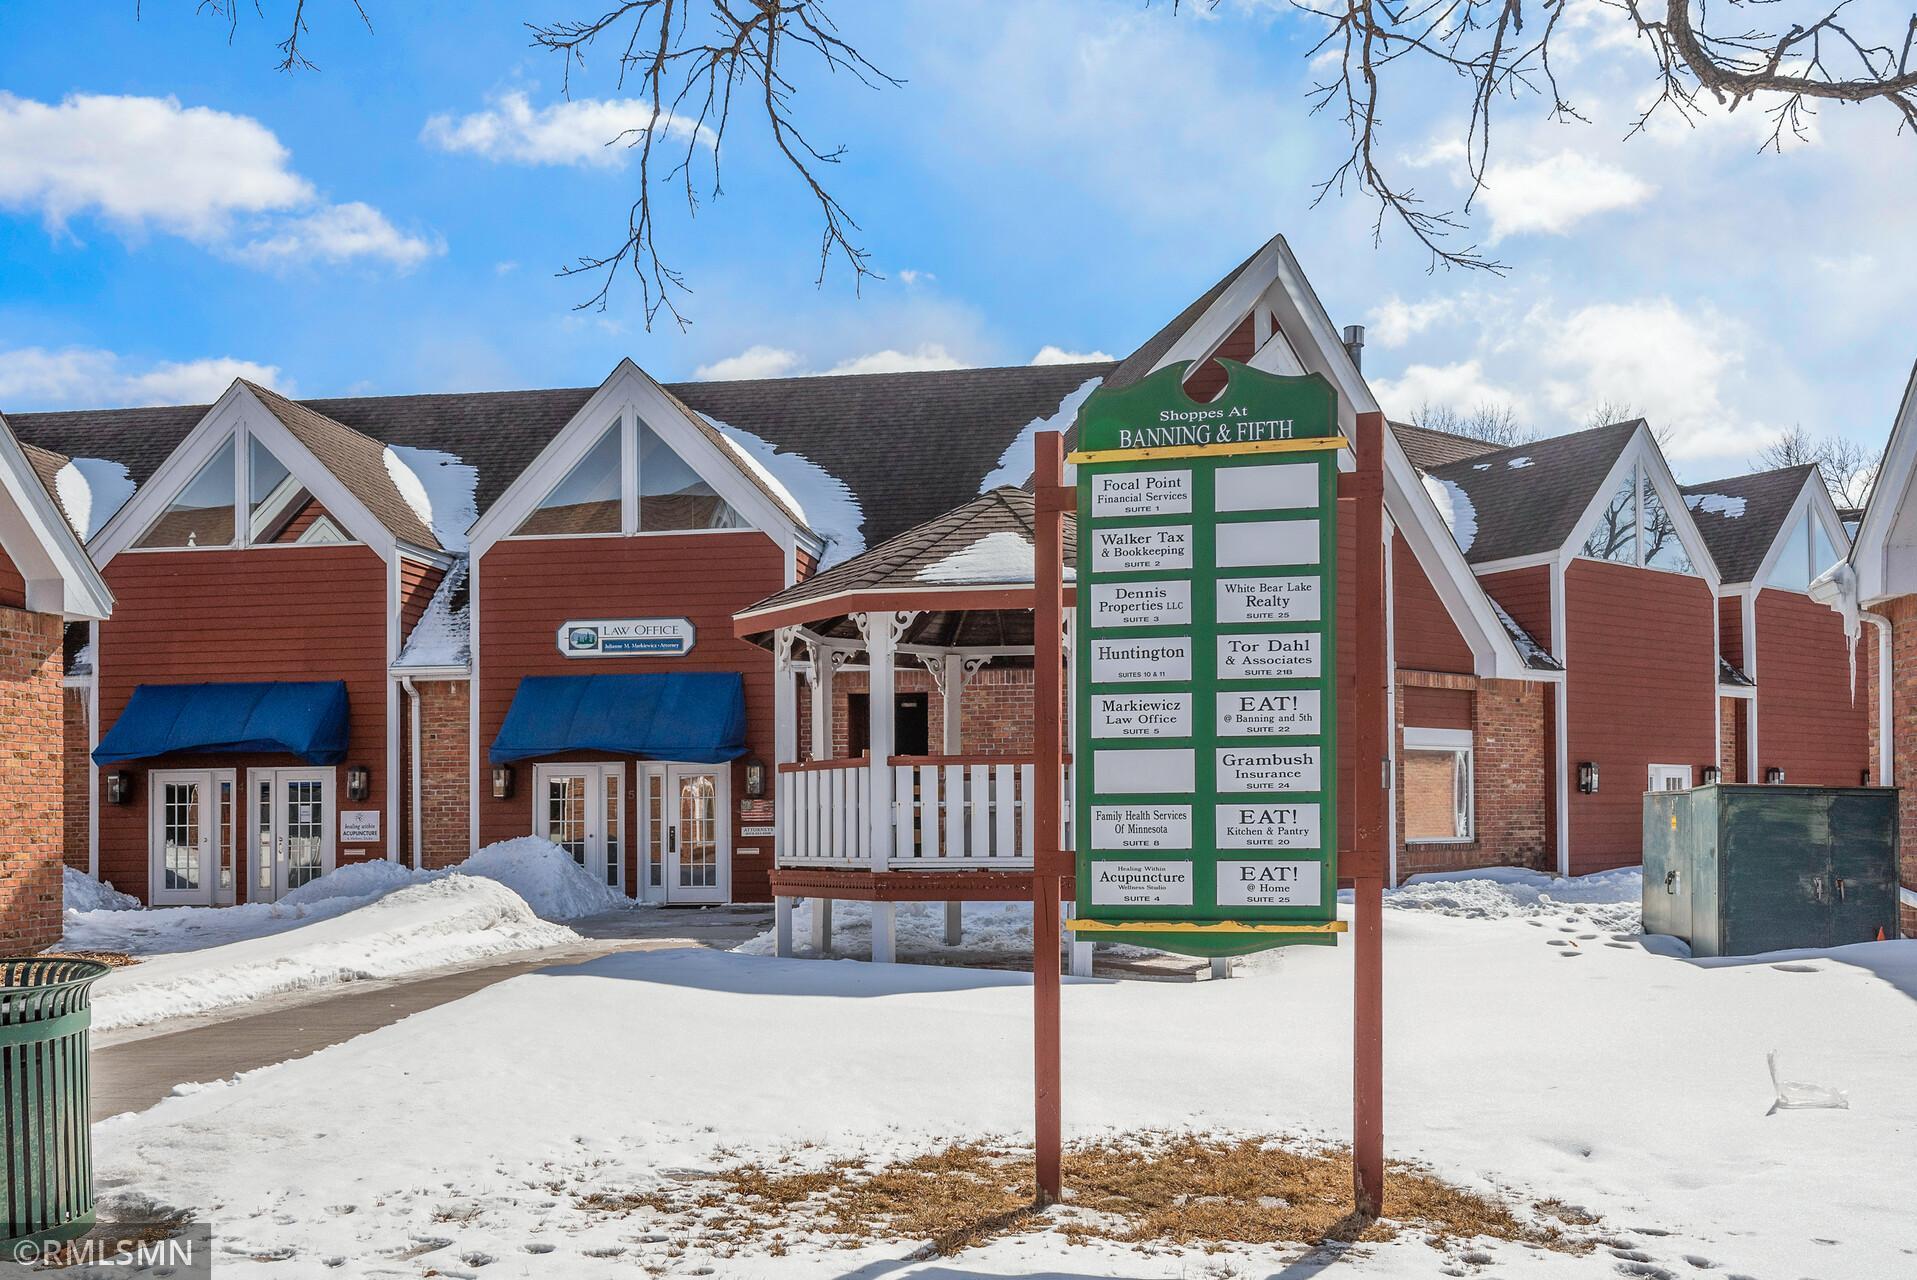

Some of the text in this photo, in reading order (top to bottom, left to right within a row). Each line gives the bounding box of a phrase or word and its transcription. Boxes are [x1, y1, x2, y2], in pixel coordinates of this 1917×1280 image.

[1160, 407, 1247, 422] Shoppes At
[1119, 420, 1293, 449] BANNING & FIFTH
[1103, 477, 1182, 491] Focal Point
[1097, 492, 1187, 504] Financial Services
[1100, 532, 1184, 545] Walker Tax
[1101, 546, 1184, 557] & Bookkeeping
[1116, 587, 1167, 599] Dennis
[1225, 583, 1312, 593] White Bear Lake
[1099, 601, 1183, 613] Properties LLC
[1246, 595, 1290, 608] Realty
[603, 625, 678, 635] LAW OFFICE
[1228, 640, 1310, 652] Tor Dahl
[1098, 645, 1184, 661] Huntington
[1225, 655, 1312, 665] & Associates
[1102, 700, 1181, 712] Markiewicz
[1240, 696, 1298, 712] EAT!
[1105, 715, 1177, 725] Law Office
[1224, 713, 1312, 723] @ Banning and 5th
[1223, 753, 1313, 766] Grambush
[1235, 770, 1301, 779] Insurance
[1096, 810, 1187, 821] Family Health Services
[1239, 809, 1297, 824] EAT!
[1114, 824, 1168, 833] Of Minnesota
[1227, 827, 1309, 837] Kitchen & Pantry
[1099, 871, 1185, 884] Acupuncture
[1240, 866, 1298, 881] EAT!
[1247, 884, 1290, 892] @ Home
